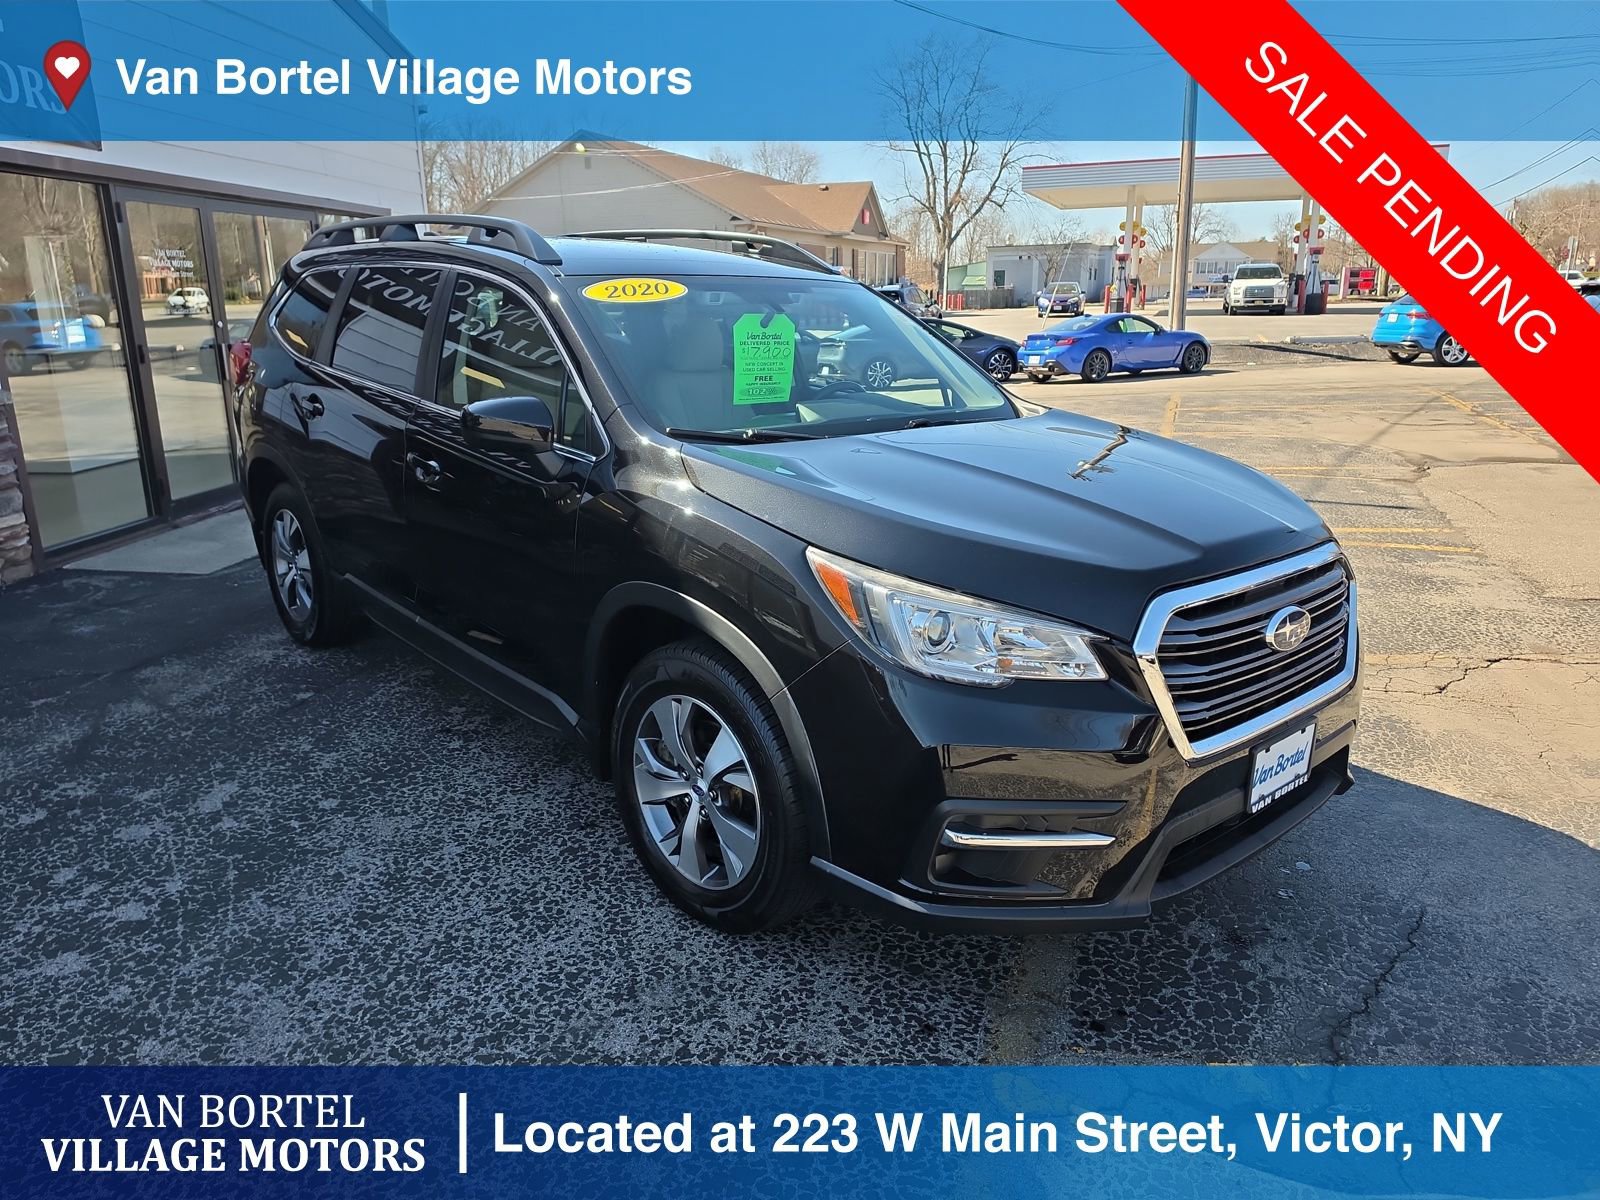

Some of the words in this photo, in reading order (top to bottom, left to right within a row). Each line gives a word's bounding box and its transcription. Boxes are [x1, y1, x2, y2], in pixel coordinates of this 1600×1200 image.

[604, 282, 669, 299] 2020
[746, 332, 760, 340] Van
[760, 331, 783, 340] Bortel
[1252, 764, 1275, 787] Van
[1273, 741, 1309, 774] Bortel
[1251, 796, 1272, 814] VAN
[1274, 774, 1308, 799] BORTEL
